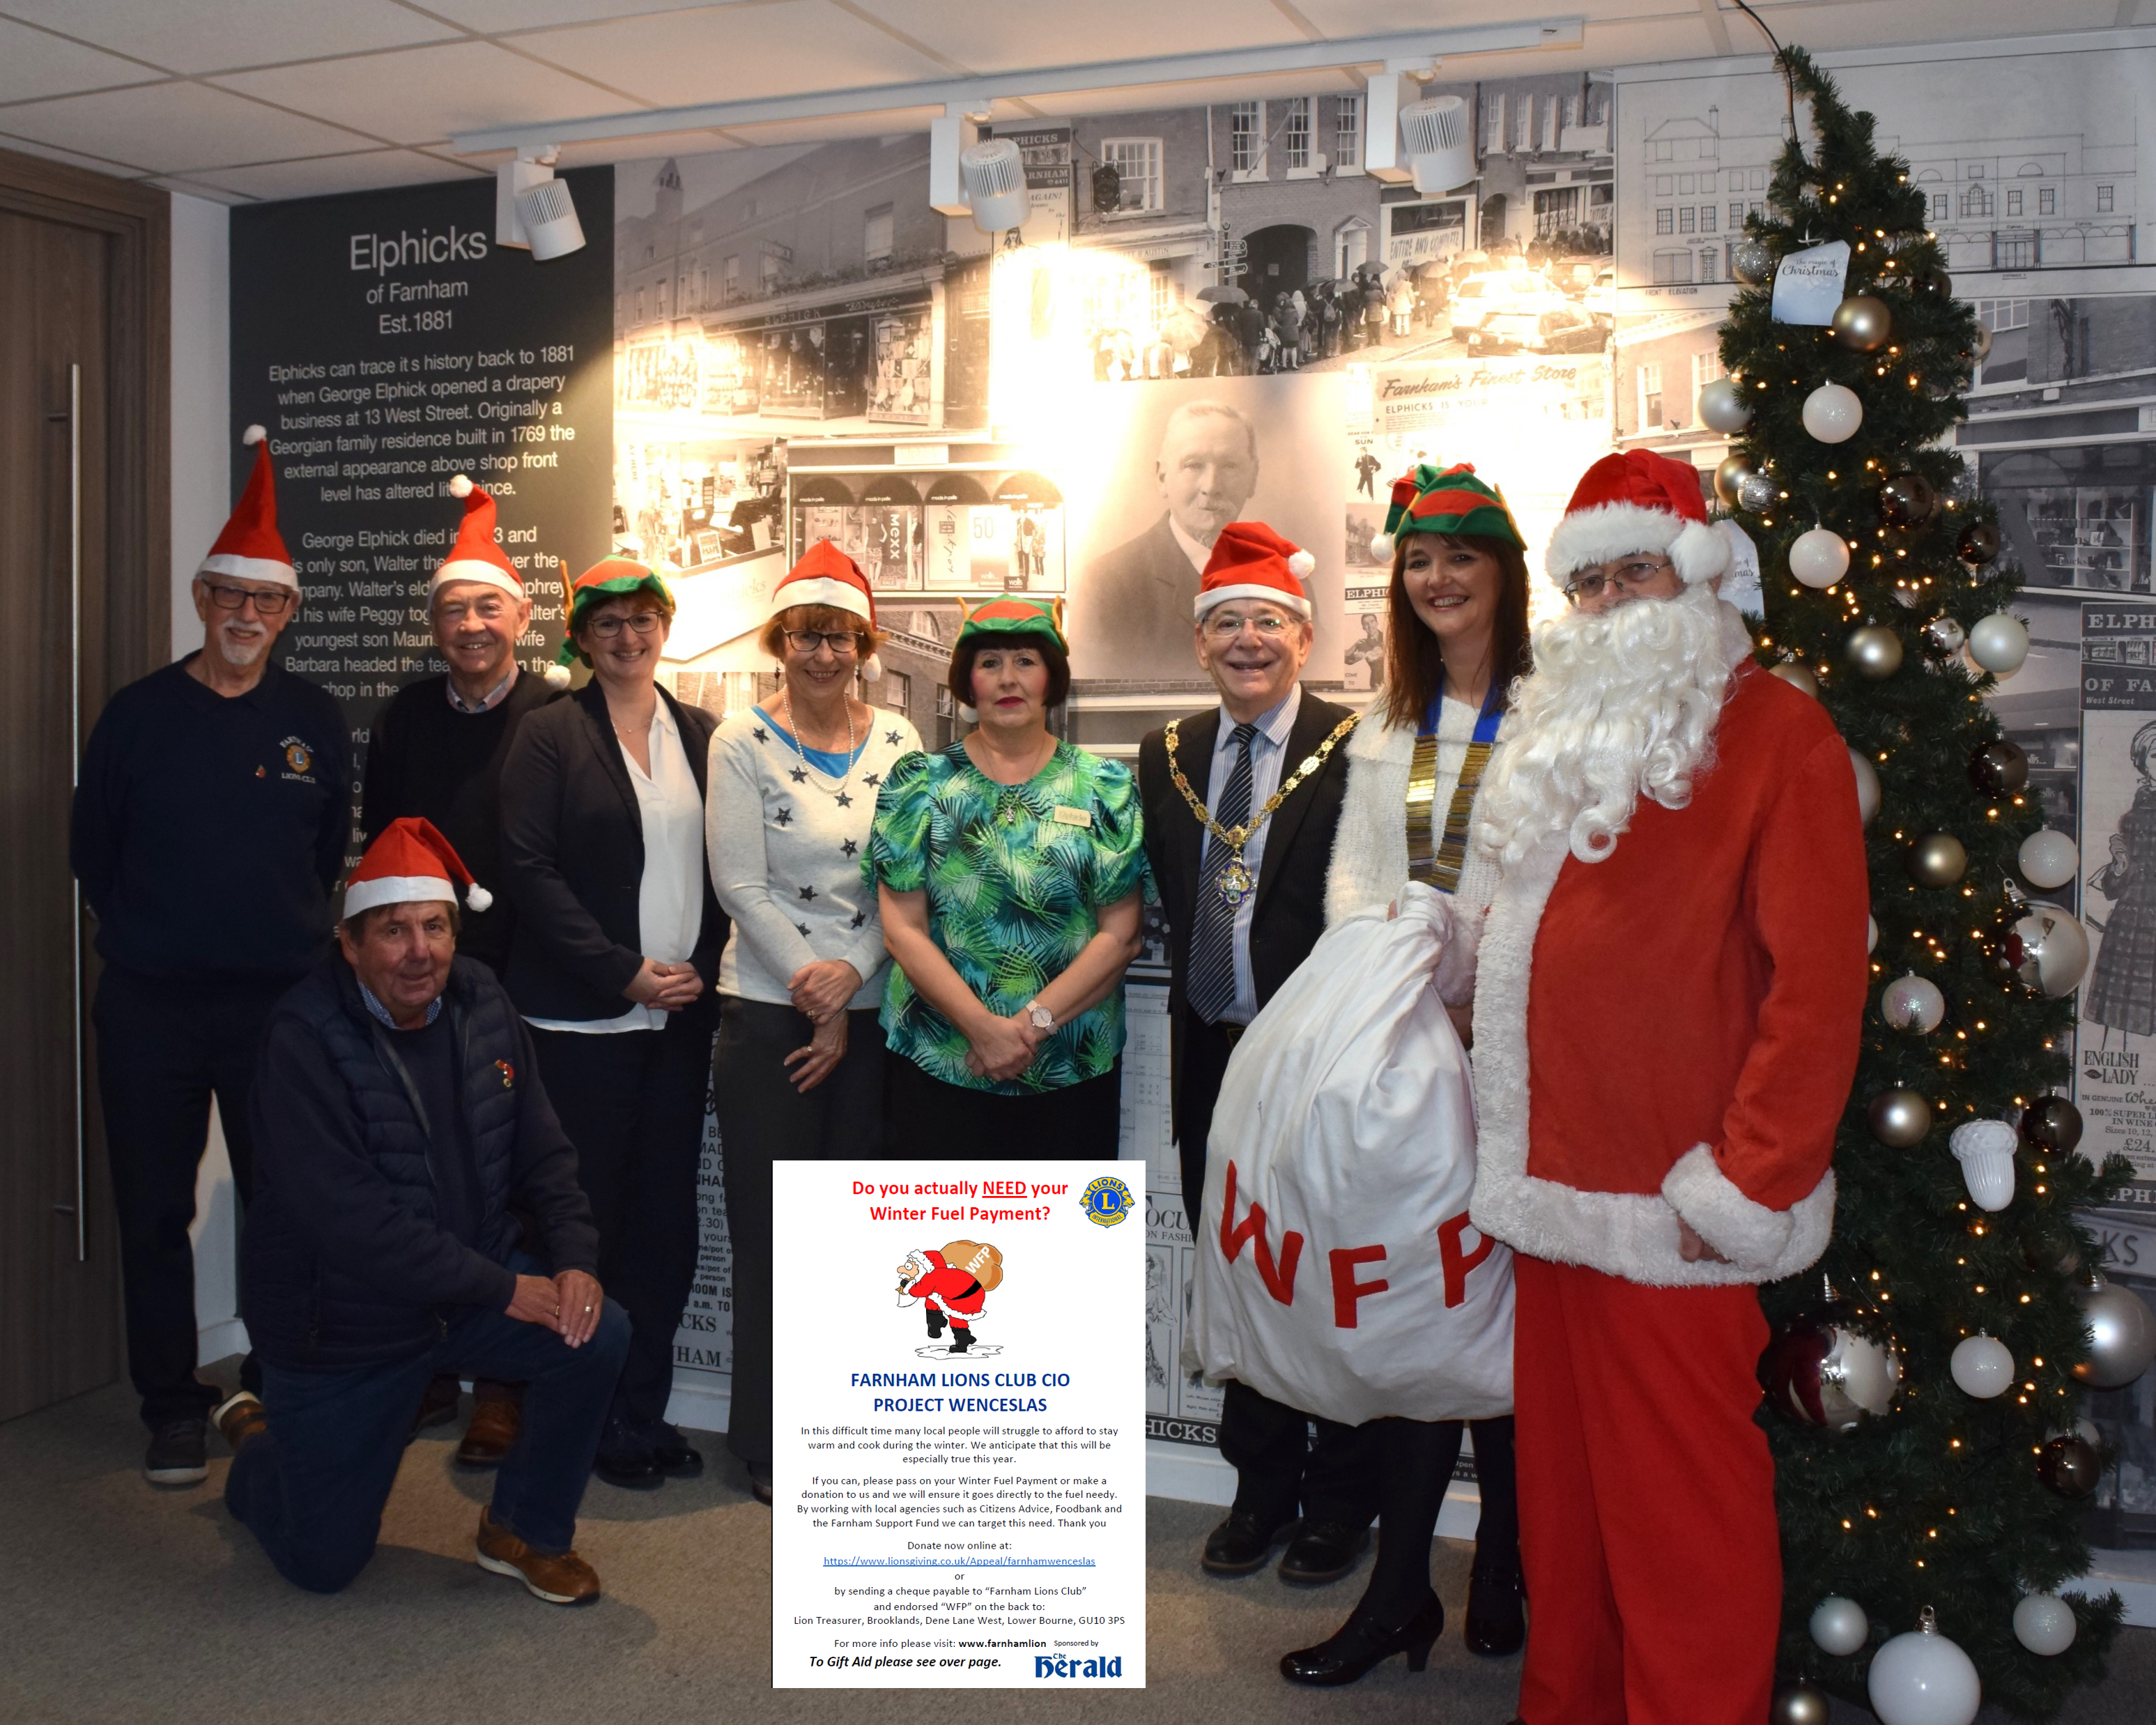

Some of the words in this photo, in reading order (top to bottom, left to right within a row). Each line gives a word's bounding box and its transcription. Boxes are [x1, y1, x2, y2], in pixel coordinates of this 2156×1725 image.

[1012, 134, 1058, 145] PHICKS
[351, 226, 486, 276] Elphicks
[1782, 265, 1840, 277] Christmas
[1829, 259, 1836, 268] of
[367, 284, 383, 304] of
[390, 280, 468, 302] Farnham
[380, 310, 452, 334] Est.1881
[270, 364, 325, 383] Elphicks
[330, 364, 355, 376] can
[360, 361, 395, 374] trace
[425, 355, 473, 371] history
[478, 350, 514, 367] back
[520, 350, 534, 364] to
[541, 346, 573, 362] 1881
[278, 390, 314, 404] when
[319, 387, 371, 404] George
[376, 381, 426, 401] Elphick
[431, 377, 486, 398] opened
[493, 380, 501, 392] a
[507, 375, 565, 393] drapery
[1383, 375, 1463, 399] Farnham's
[1469, 369, 1526, 388] Finest
[1531, 365, 1577, 382] Store
[282, 414, 341, 429] business
[346, 411, 359, 426] at
[365, 409, 380, 424] 13
[385, 407, 421, 423] West
[426, 404, 472, 421] Street.
[478, 399, 548, 421] Originally
[552, 402, 562, 414] a
[1385, 402, 1433, 414] ELPHICKS
[1442, 401, 1449, 409] IS
[270, 438, 332, 457] Georgian
[337, 435, 377, 453] family
[382, 432, 451, 448] residence
[456, 429, 486, 445] built
[492, 428, 505, 443] in
[511, 425, 545, 442] 1769
[550, 424, 575, 440] the
[284, 461, 338, 478] external
[343, 461, 426, 478] appearance
[431, 456, 475, 472] above
[481, 454, 518, 473] shop
[522, 452, 557, 468] front
[321, 486, 351, 502] level
[356, 486, 380, 500] has
[386, 482, 433, 499] altered
[302, 532, 354, 551] George
[359, 530, 409, 549] Elphick
[414, 529, 445, 545] died
[508, 526, 537, 542] and
[307, 558, 335, 576] only
[340, 560, 369, 573] son,
[374, 555, 419, 572] Walter
[534, 552, 558, 568] the
[348, 581, 404, 597] Walter’s
[304, 608, 323, 622] his
[328, 606, 355, 622] wife
[361, 606, 404, 625] Peggy
[295, 633, 358, 650] youngest
[363, 635, 387, 647] son
[286, 657, 340, 672] Barbara
[344, 657, 396, 672] headed
[401, 657, 424, 671] the
[360, 682, 372, 696] in
[2085, 677, 2113, 691] OF
[2127, 679, 2156, 692] FA
[2108, 696, 2134, 705] Street
[2084, 1050, 2139, 1068] ENGLISH
[2102, 1068, 2139, 1085] LADY
[2092, 1095, 2124, 1103] GENUINE
[2090, 1108, 2112, 1117] 100%
[2113, 1110, 2146, 1119] SUPER
[2126, 1118, 2153, 1127] WINE
[1220, 1159, 1496, 1328] WFP
[700, 1254, 725, 1263] person
[700, 1274, 725, 1282] person
[693, 1300, 712, 1310] a.m.
[718, 1301, 730, 1312] TO
